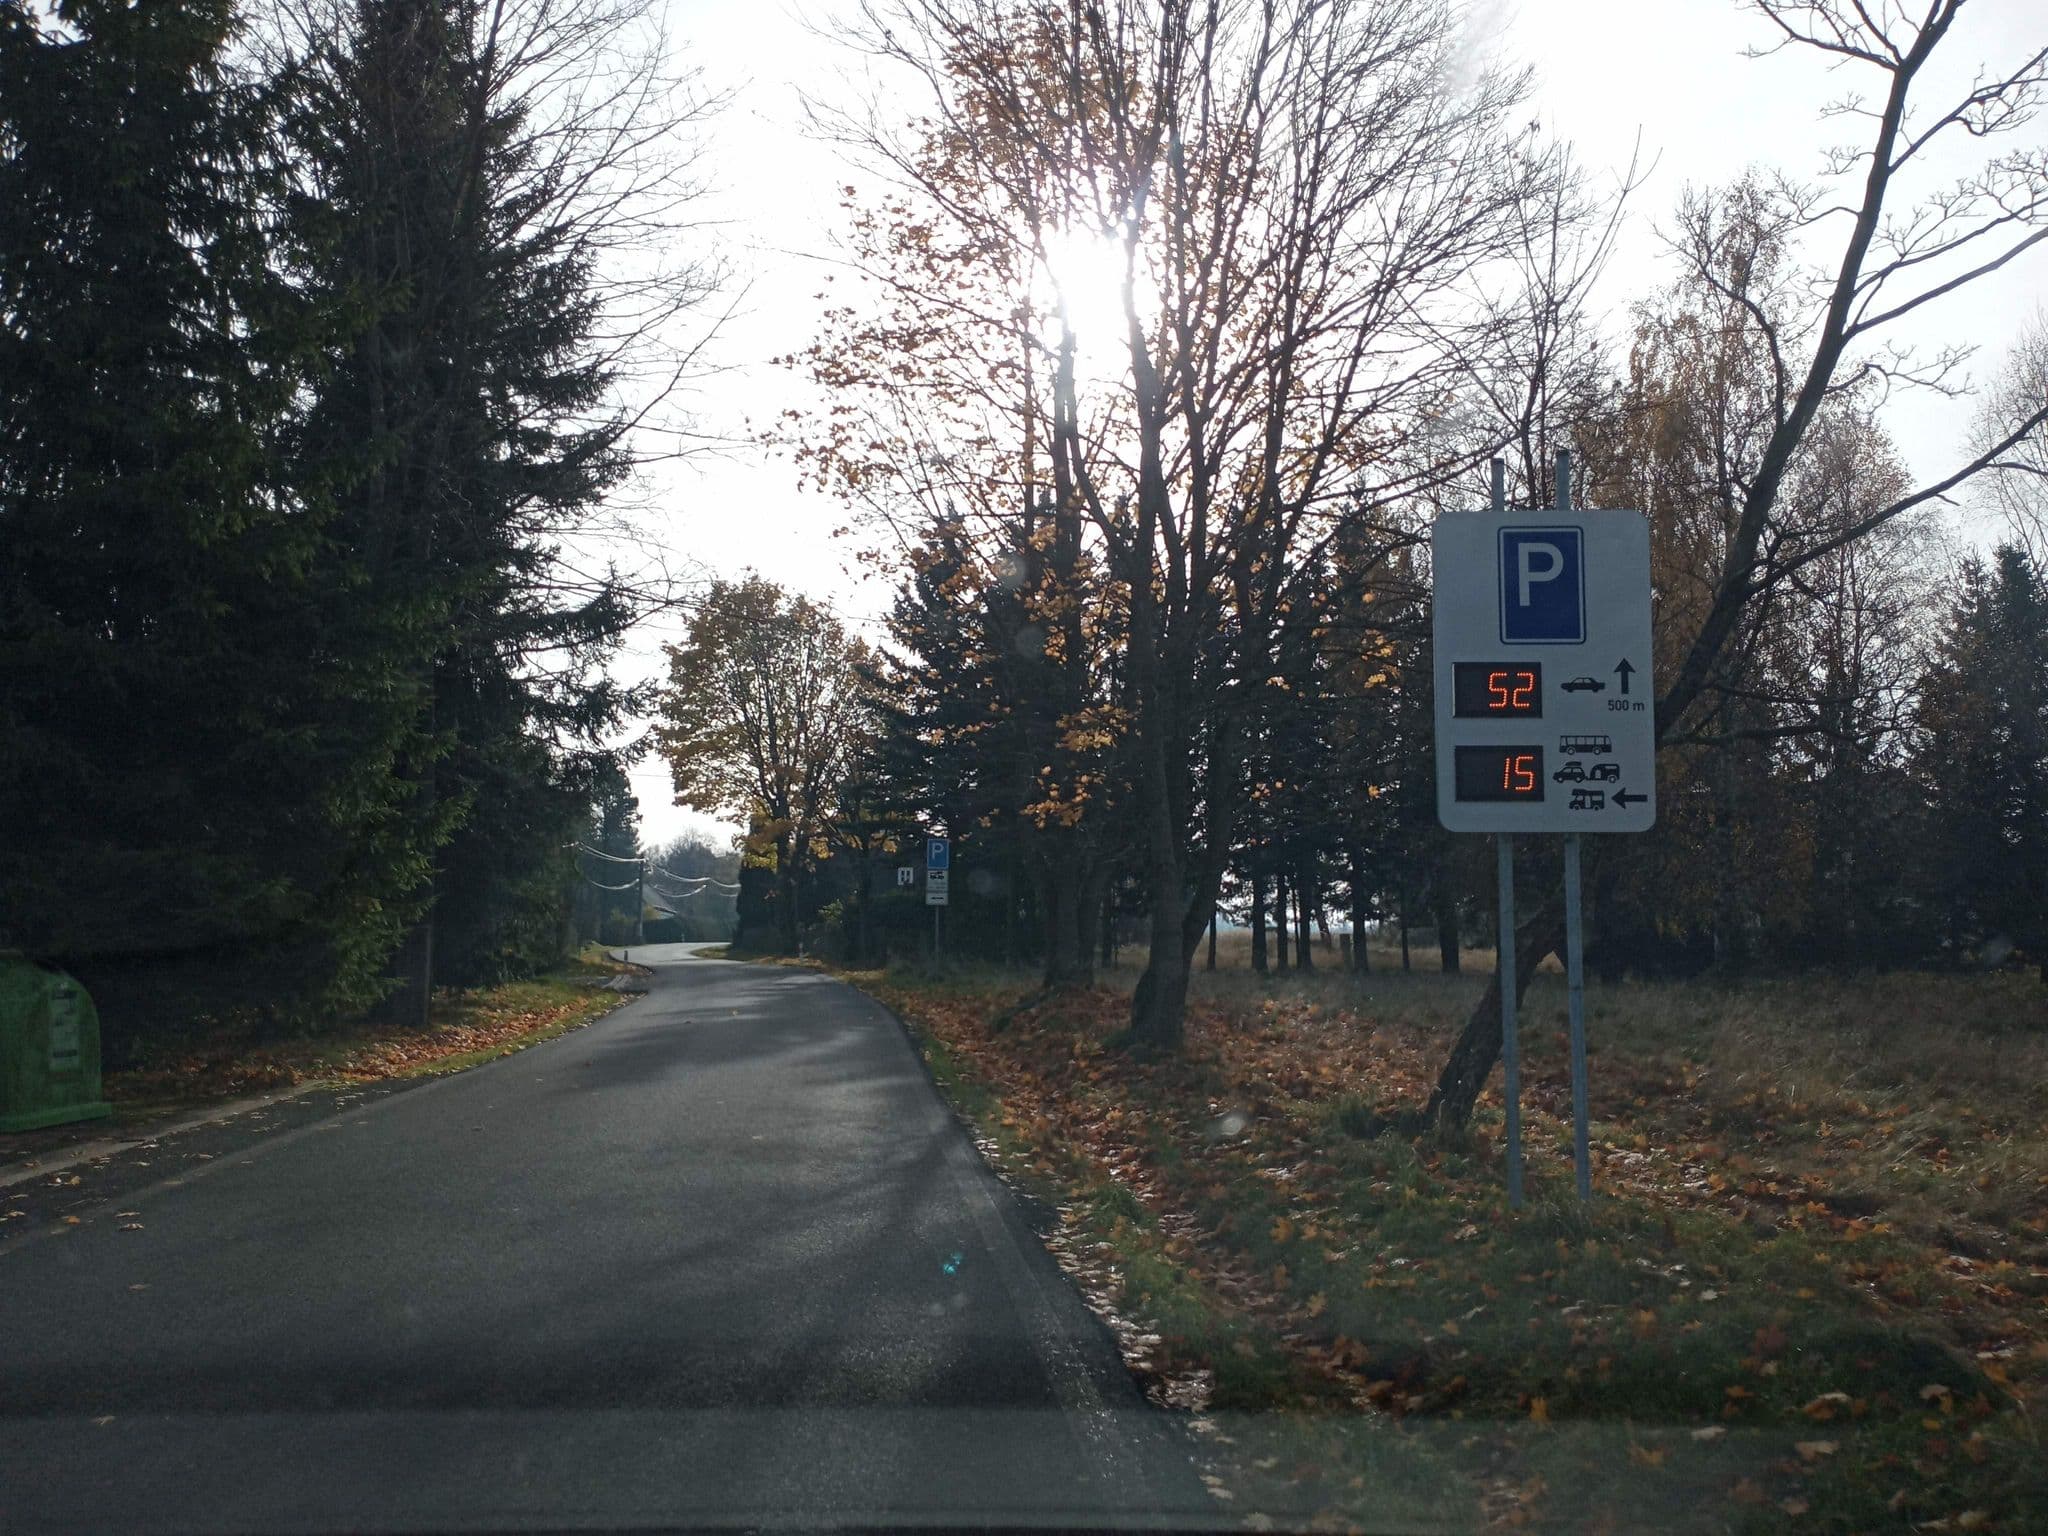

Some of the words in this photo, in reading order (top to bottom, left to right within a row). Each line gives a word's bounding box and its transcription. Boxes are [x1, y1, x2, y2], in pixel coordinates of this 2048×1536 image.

[1517, 542, 1564, 607] P
[1488, 672, 1535, 709] 52
[1607, 700, 1630, 712] 500
[1632, 701, 1645, 712] m
[1503, 755, 1535, 791] 15
[931, 842, 944, 860] P
